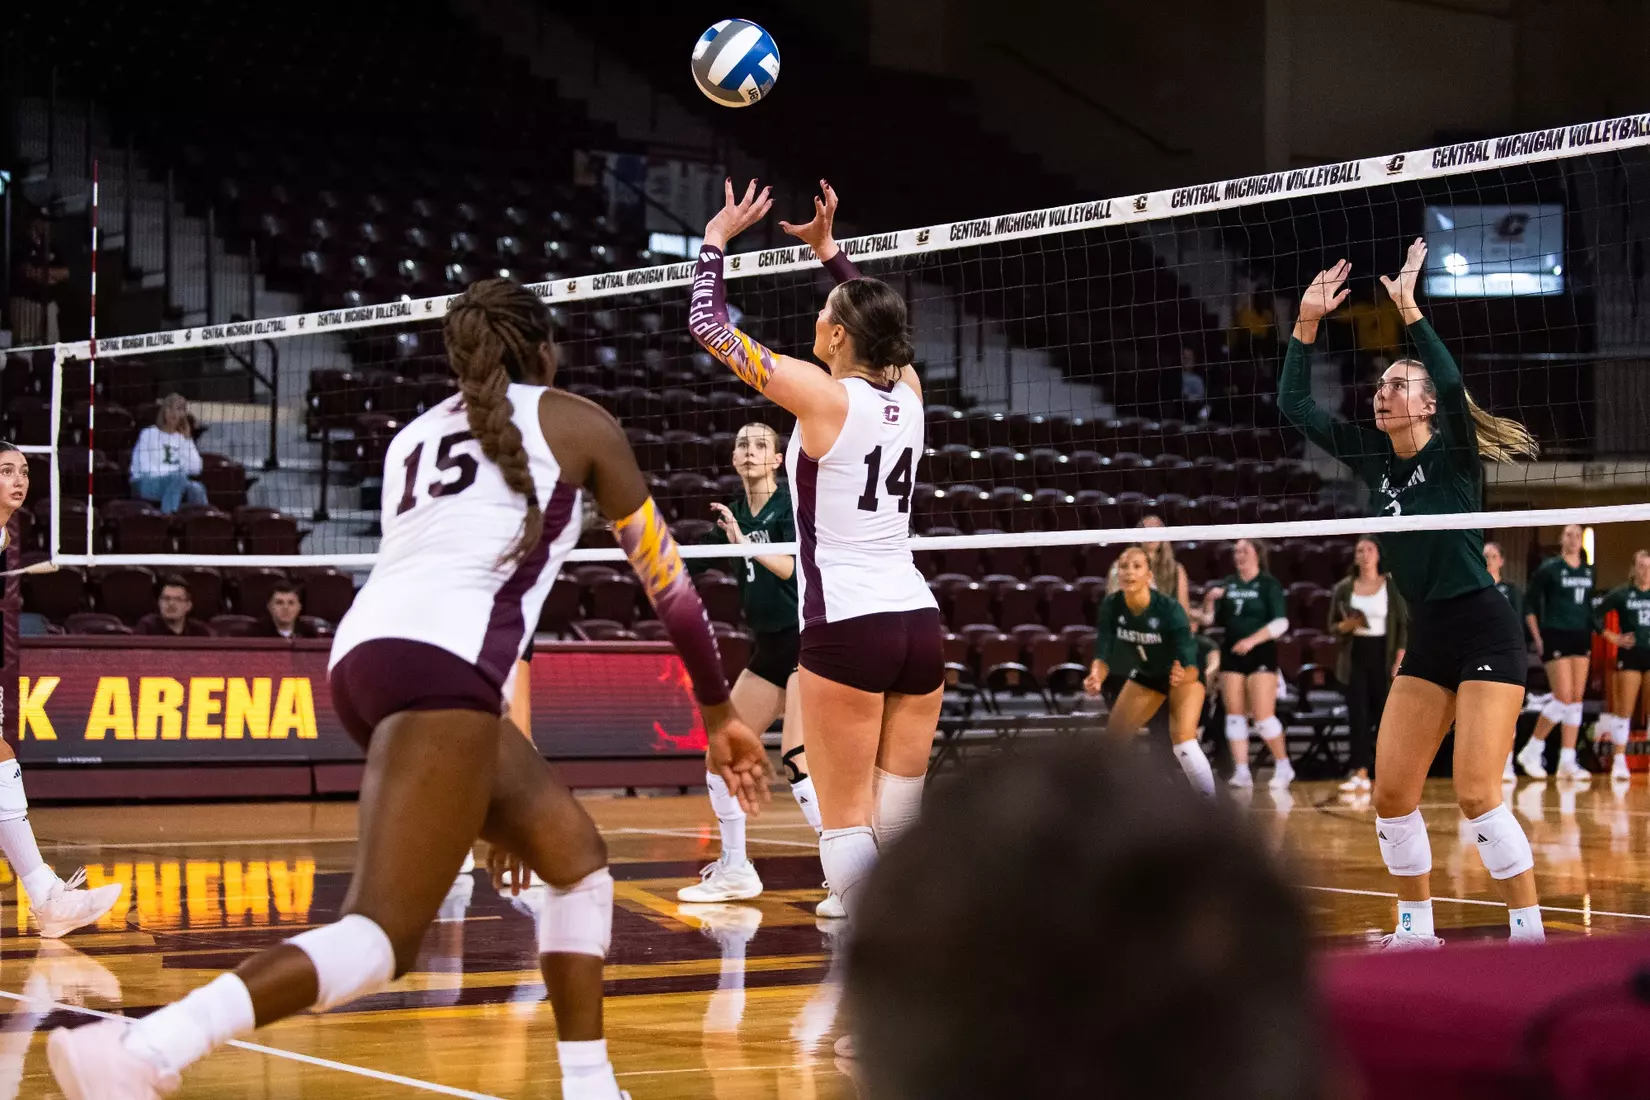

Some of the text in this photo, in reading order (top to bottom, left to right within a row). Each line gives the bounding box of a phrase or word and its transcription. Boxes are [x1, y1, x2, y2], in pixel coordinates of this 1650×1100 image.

[1432, 141, 1489, 168] CENTRAL
[1494, 128, 1564, 159] MICHIGAN
[1171, 161, 1361, 208] CENTRAL MICHIGAN VOLLEYBALL
[949, 200, 1112, 242] CENTRAL MICHIGAN VOLLEYBALL
[758, 249, 795, 268] CENTRAL
[845, 233, 899, 255] VOLLEYBALL
[592, 262, 697, 290] CENTRAL MICHIGAN VOLLEY
[689, 271, 742, 357] CHIPPEWAS
[396, 430, 479, 517] 15
[857, 444, 913, 513] 14
[84, 676, 318, 740] ARENA
